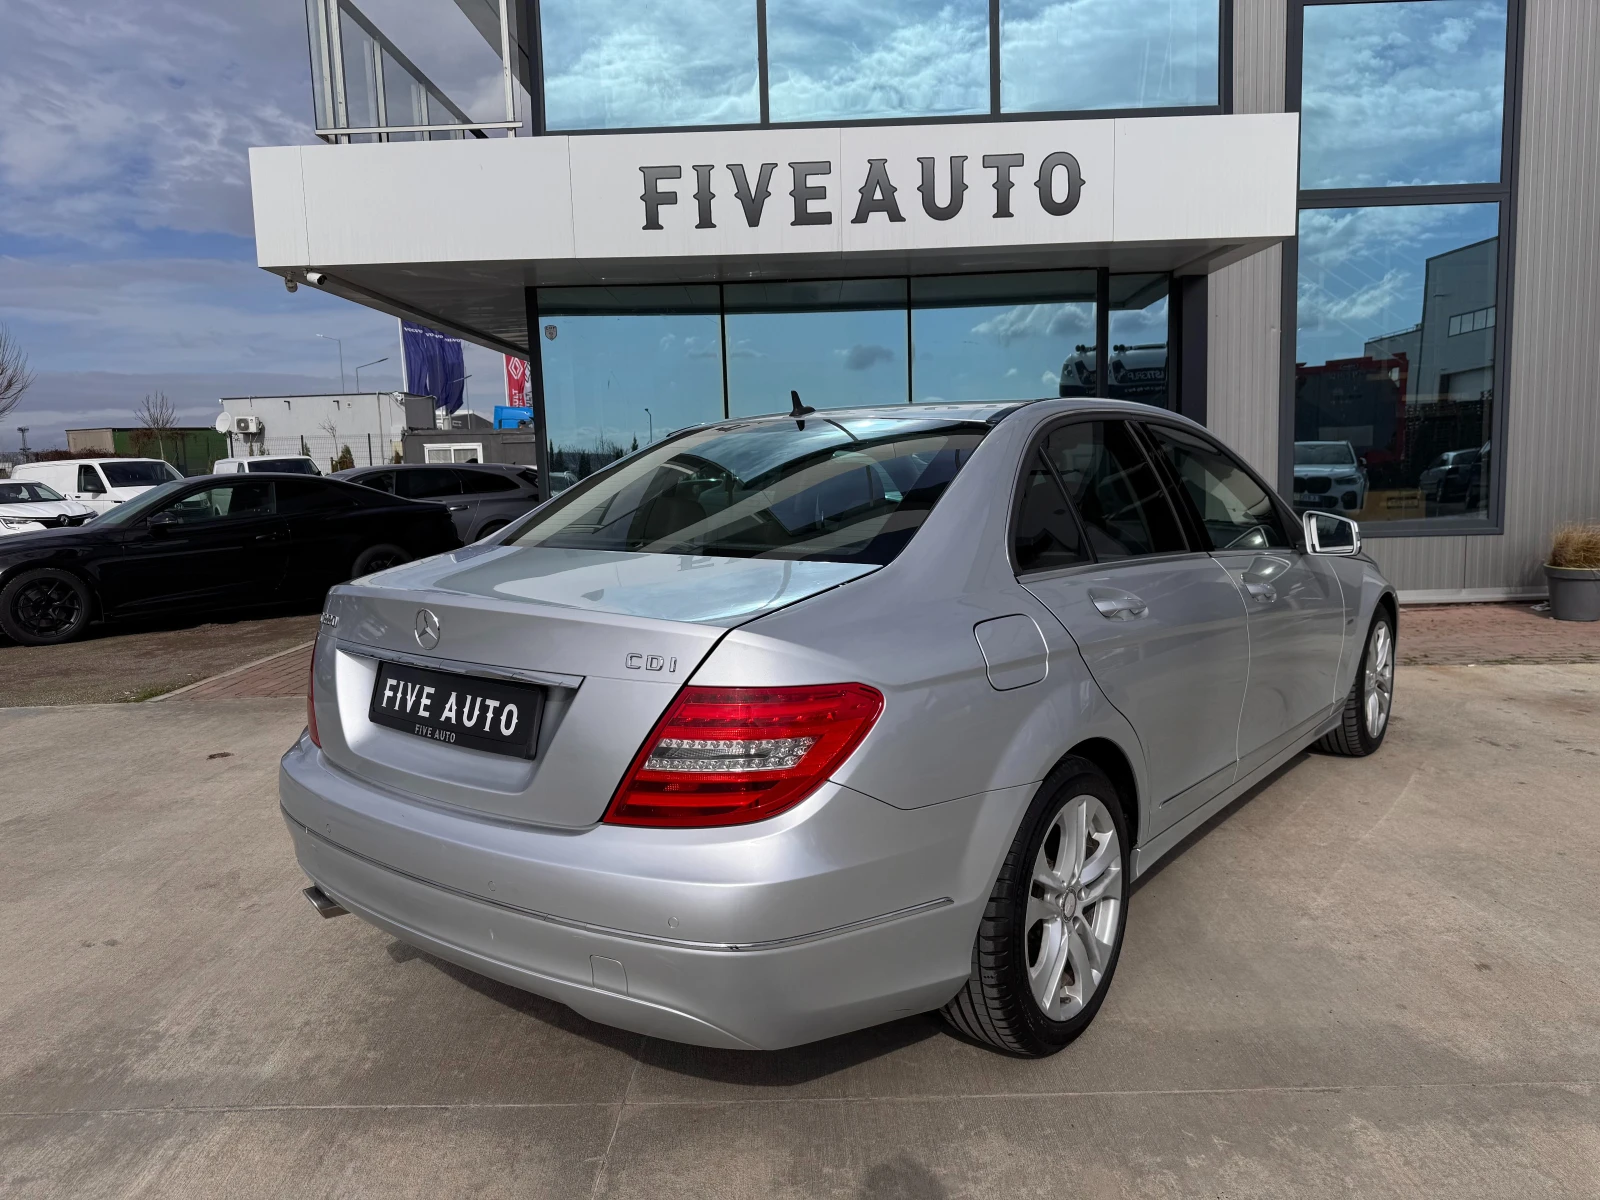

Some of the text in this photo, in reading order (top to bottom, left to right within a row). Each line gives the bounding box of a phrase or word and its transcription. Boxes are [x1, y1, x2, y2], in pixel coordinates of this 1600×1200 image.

[624, 652, 678, 672] CDI
[381, 678, 519, 736] FIVE AUTO
[414, 724, 456, 743] FIVE AUTO
